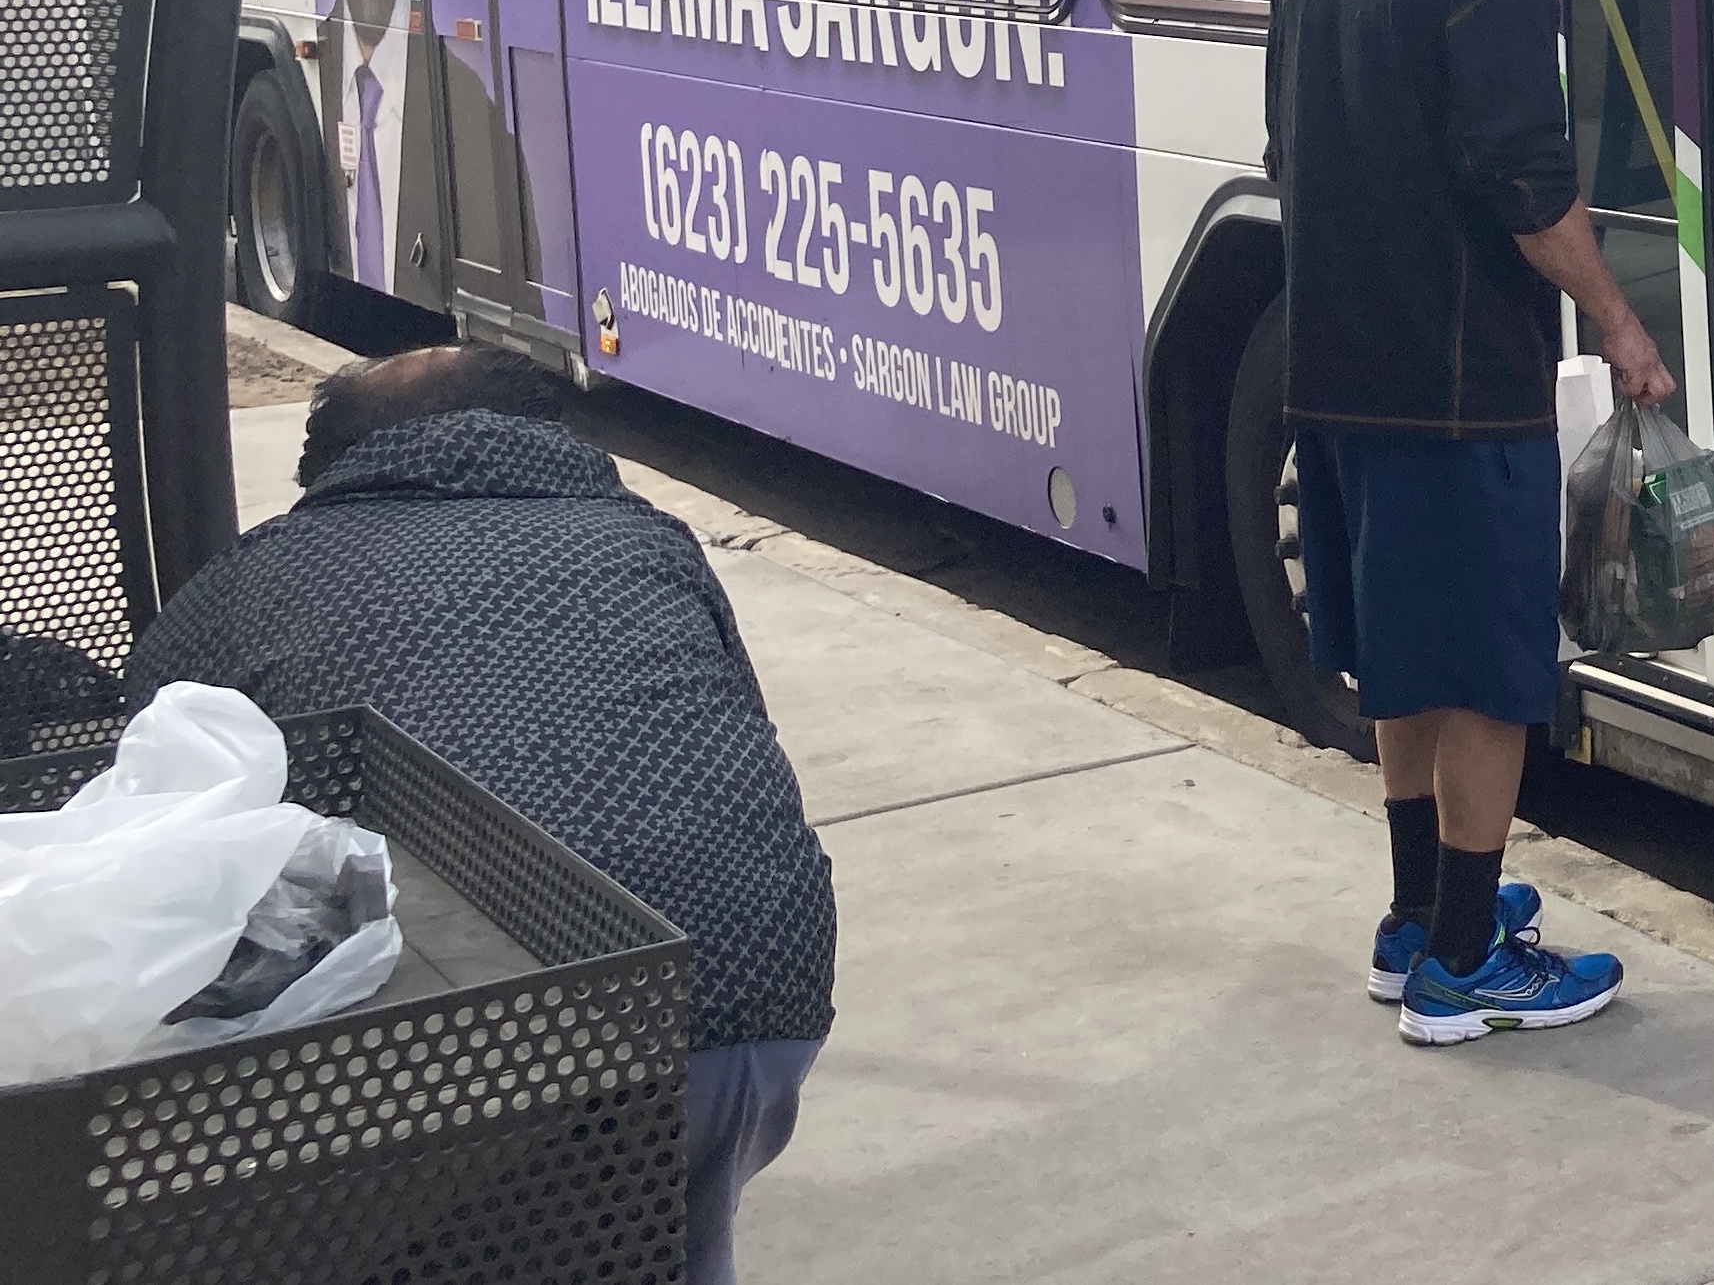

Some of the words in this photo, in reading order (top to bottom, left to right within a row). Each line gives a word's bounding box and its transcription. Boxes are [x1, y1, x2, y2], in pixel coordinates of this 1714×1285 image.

[640, 122, 748, 264] (623)
[759, 148, 1003, 333] 225-5635
[619, 261, 700, 335] ABOGADOS
[700, 288, 724, 342] DE
[726, 297, 836, 382] ACCIDENTES
[851, 333, 933, 411] SARGON
[935, 356, 983, 427] LAW
[987, 370, 1062, 449] GROUP
